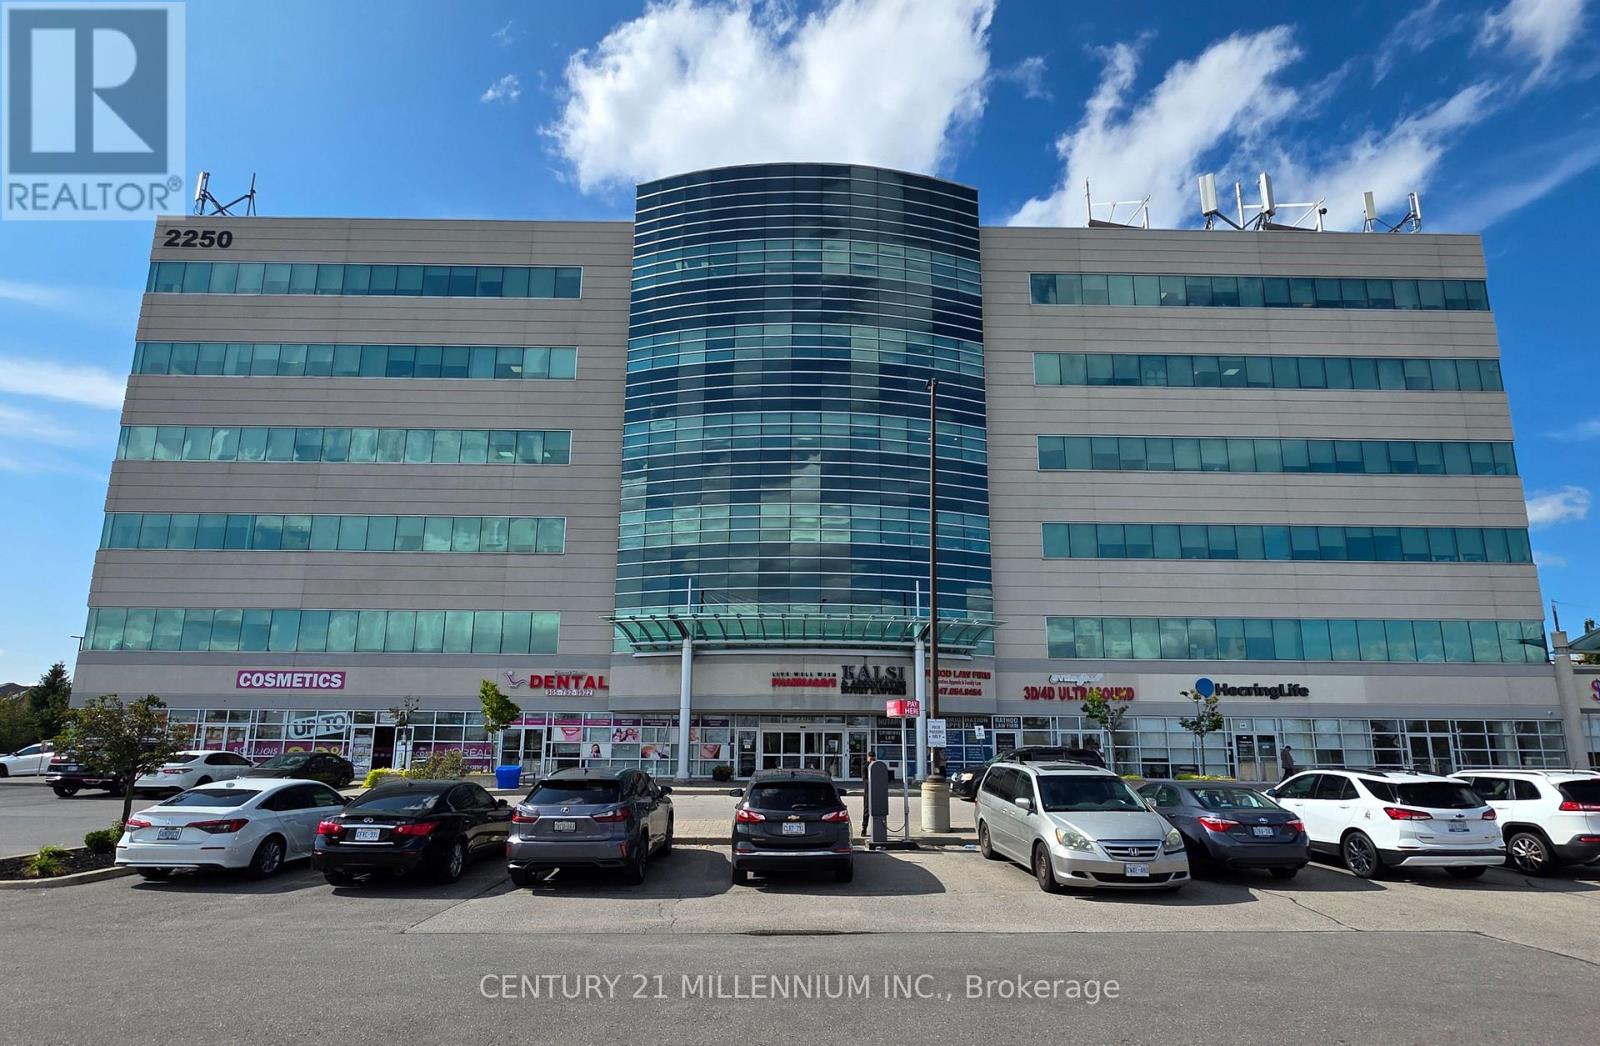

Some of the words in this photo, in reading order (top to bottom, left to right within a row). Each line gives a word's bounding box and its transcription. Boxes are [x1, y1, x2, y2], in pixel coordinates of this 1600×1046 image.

[163, 229, 233, 248] 2250
[239, 672, 342, 688] COSMETICS
[841, 665, 905, 680] KALSI
[529, 674, 609, 689] DENTAL
[1023, 687, 1056, 700] 3D/4D
[1215, 683, 1310, 700] HearingLife
[294, 720, 316, 736] UP
[322, 714, 346, 731] TO
